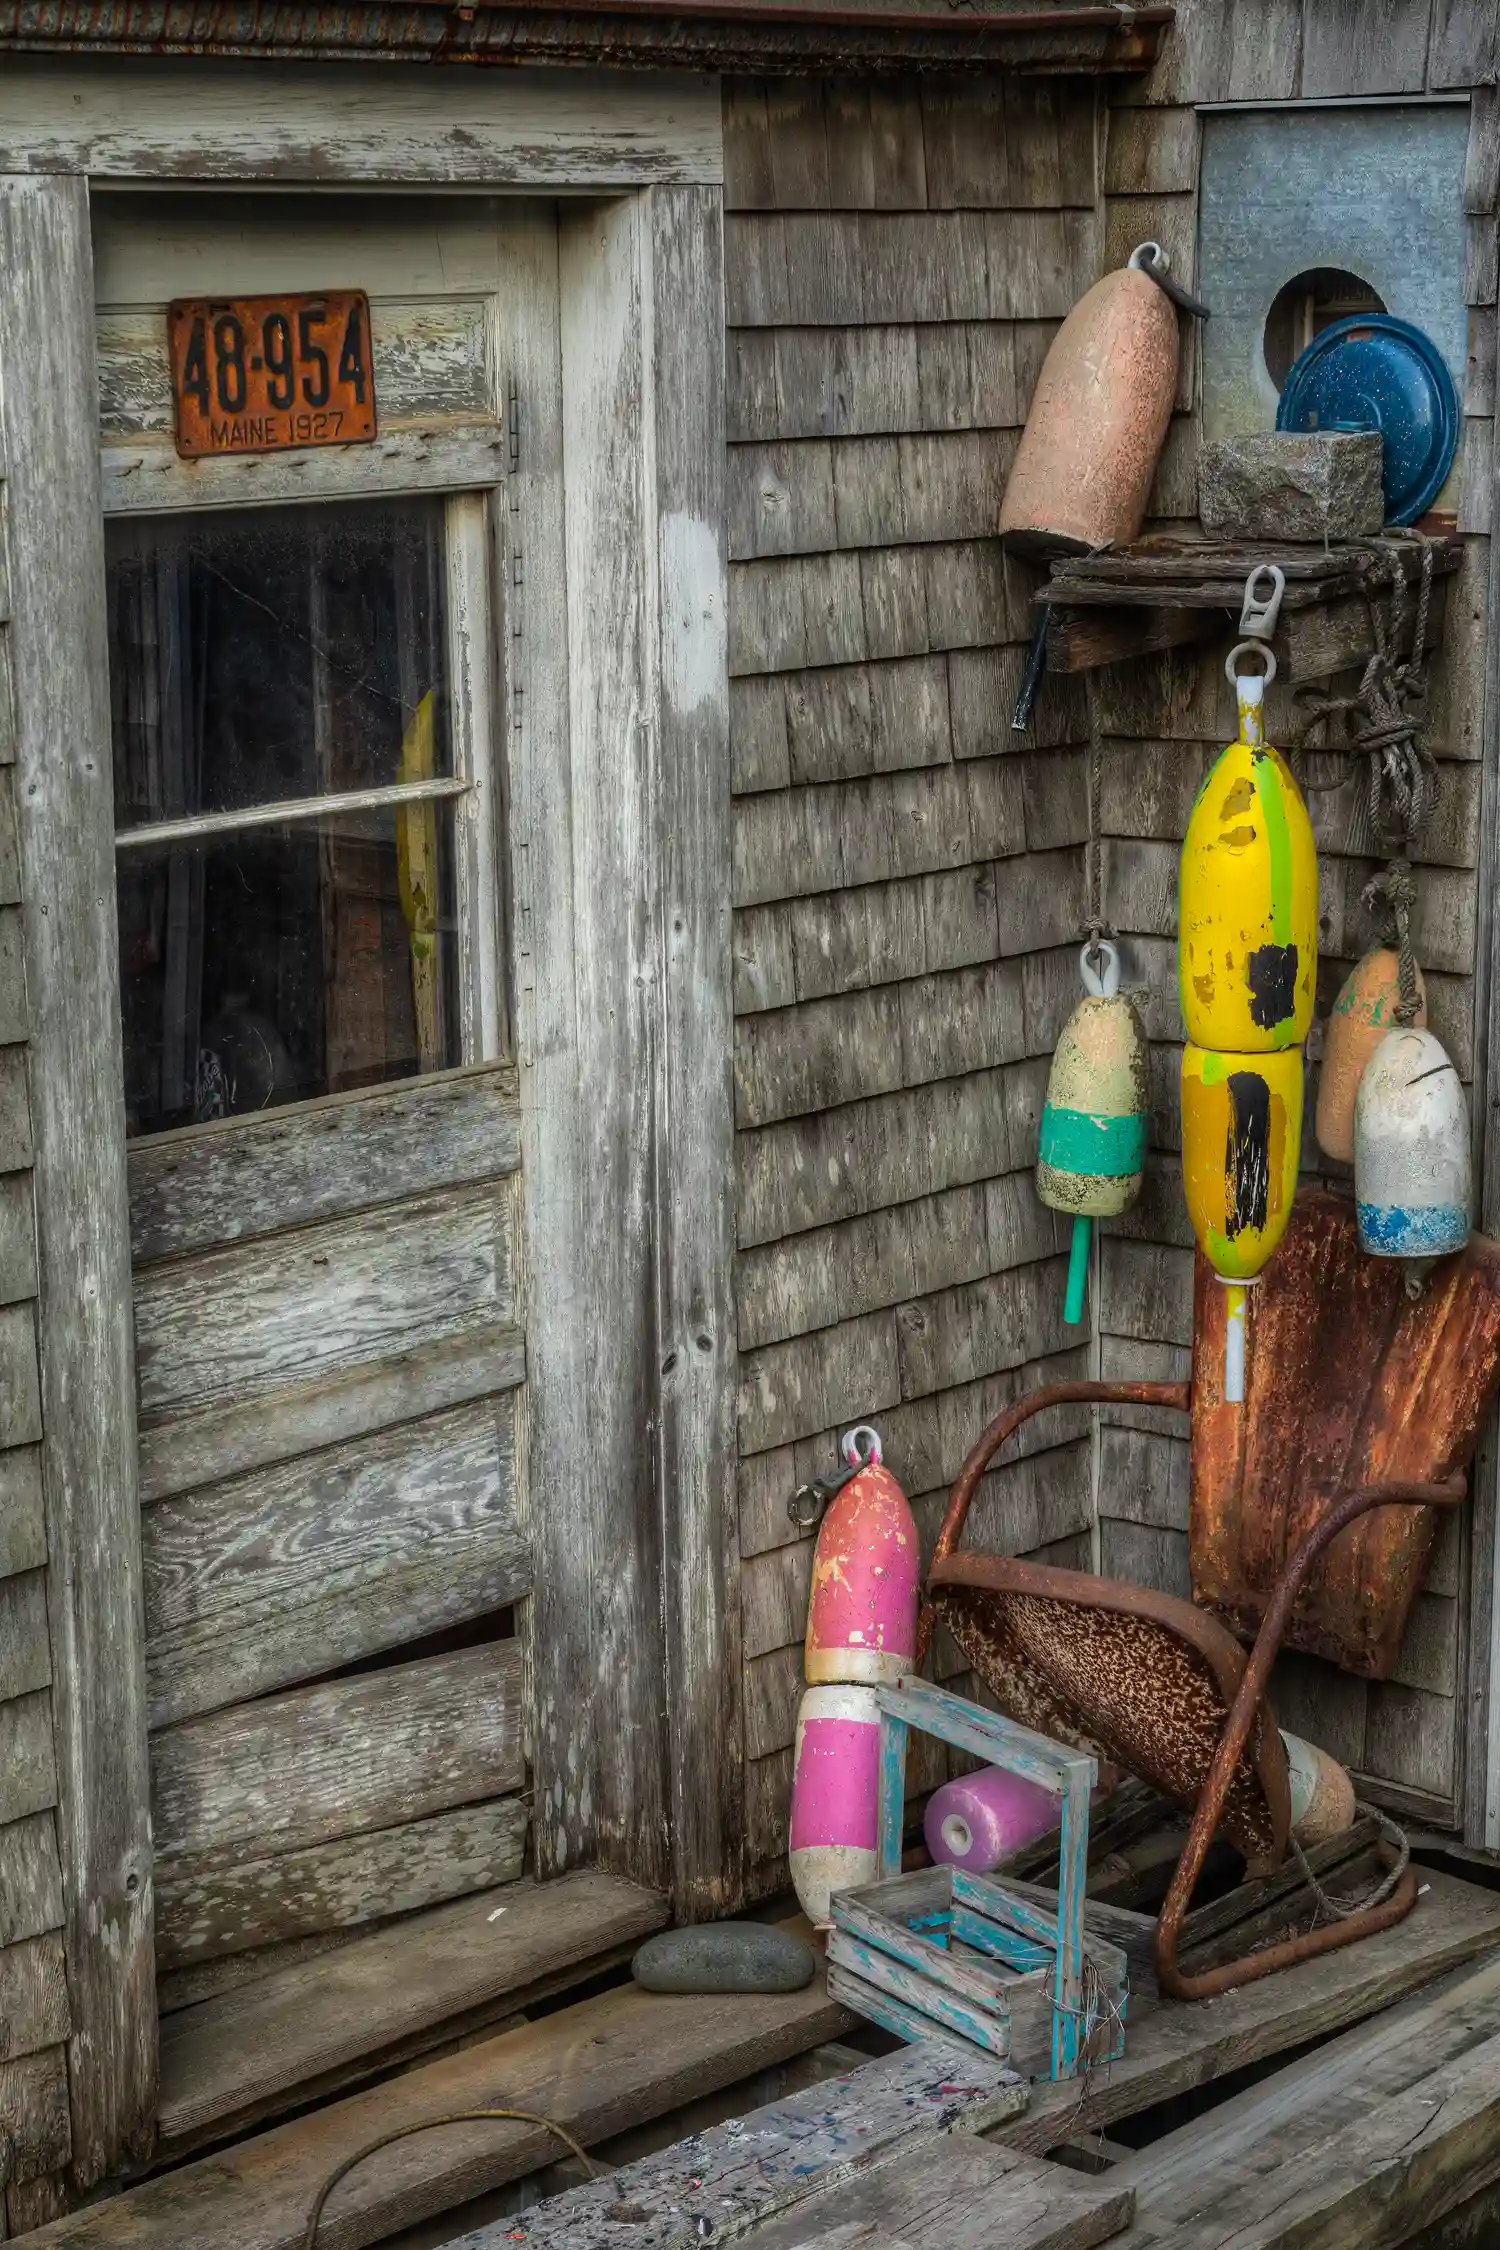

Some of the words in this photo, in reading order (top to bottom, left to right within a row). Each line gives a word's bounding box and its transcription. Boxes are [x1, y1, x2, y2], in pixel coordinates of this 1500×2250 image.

[183, 309, 366, 416] 48-954
[210, 417, 277, 446] MAINE
[288, 411, 344, 442] 1927
